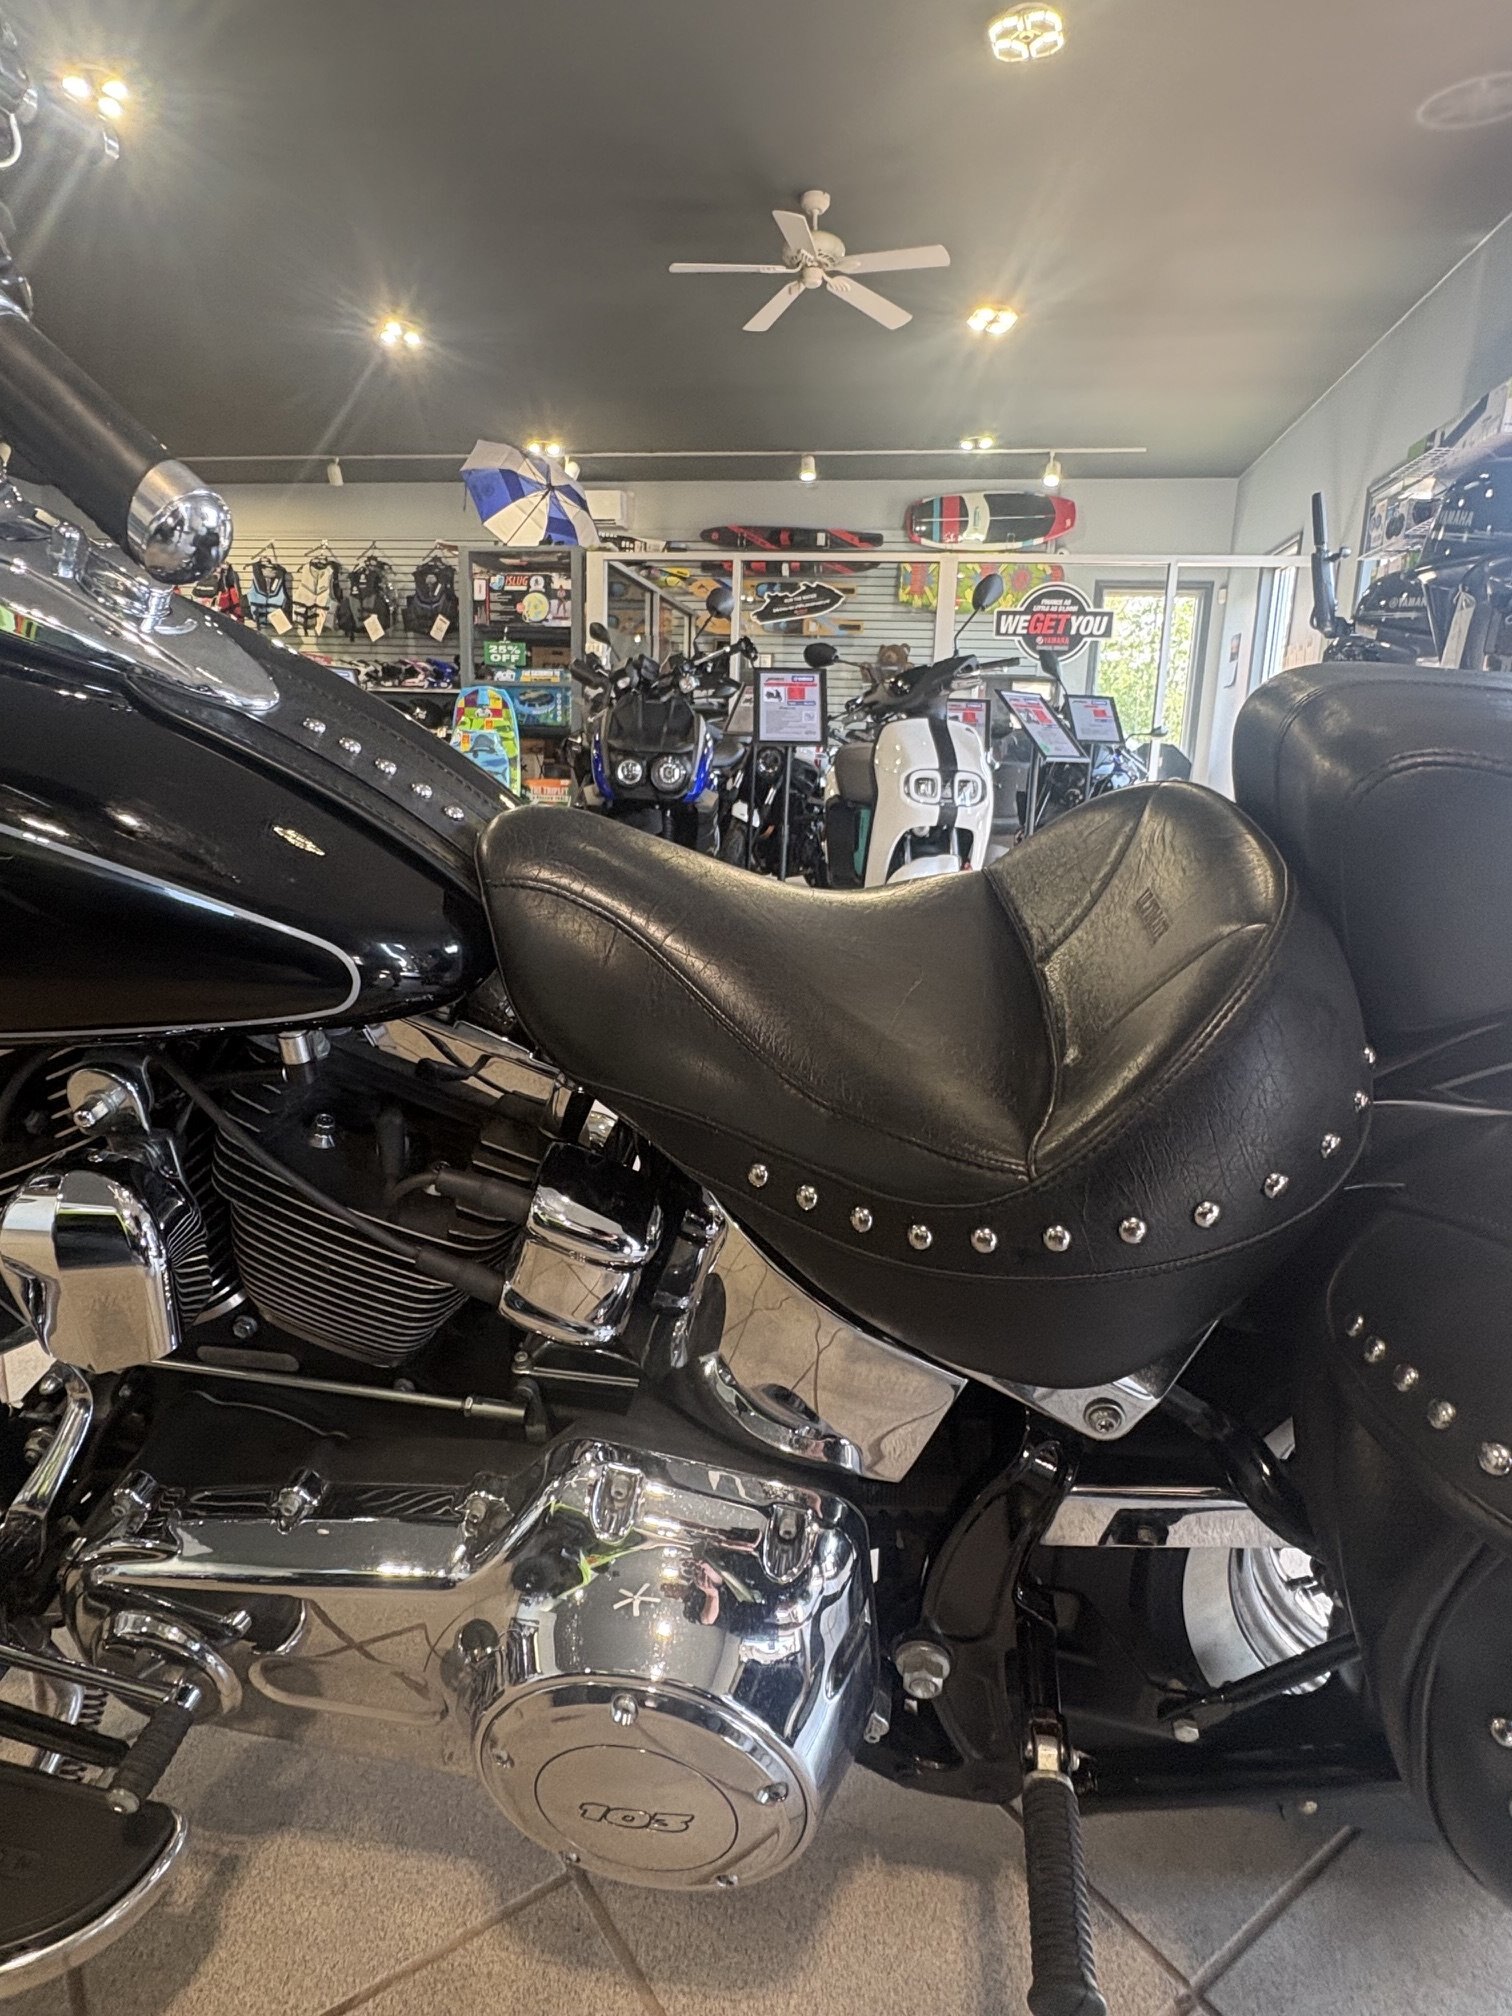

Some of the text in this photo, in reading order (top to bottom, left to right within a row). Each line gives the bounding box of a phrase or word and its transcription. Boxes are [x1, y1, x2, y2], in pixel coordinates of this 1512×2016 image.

[1439, 510, 1474, 526] YAMAHA
[1000, 613, 1108, 635] WE GET YOU
[488, 645, 521, 655] 25%
[490, 654, 520, 663] OFF
